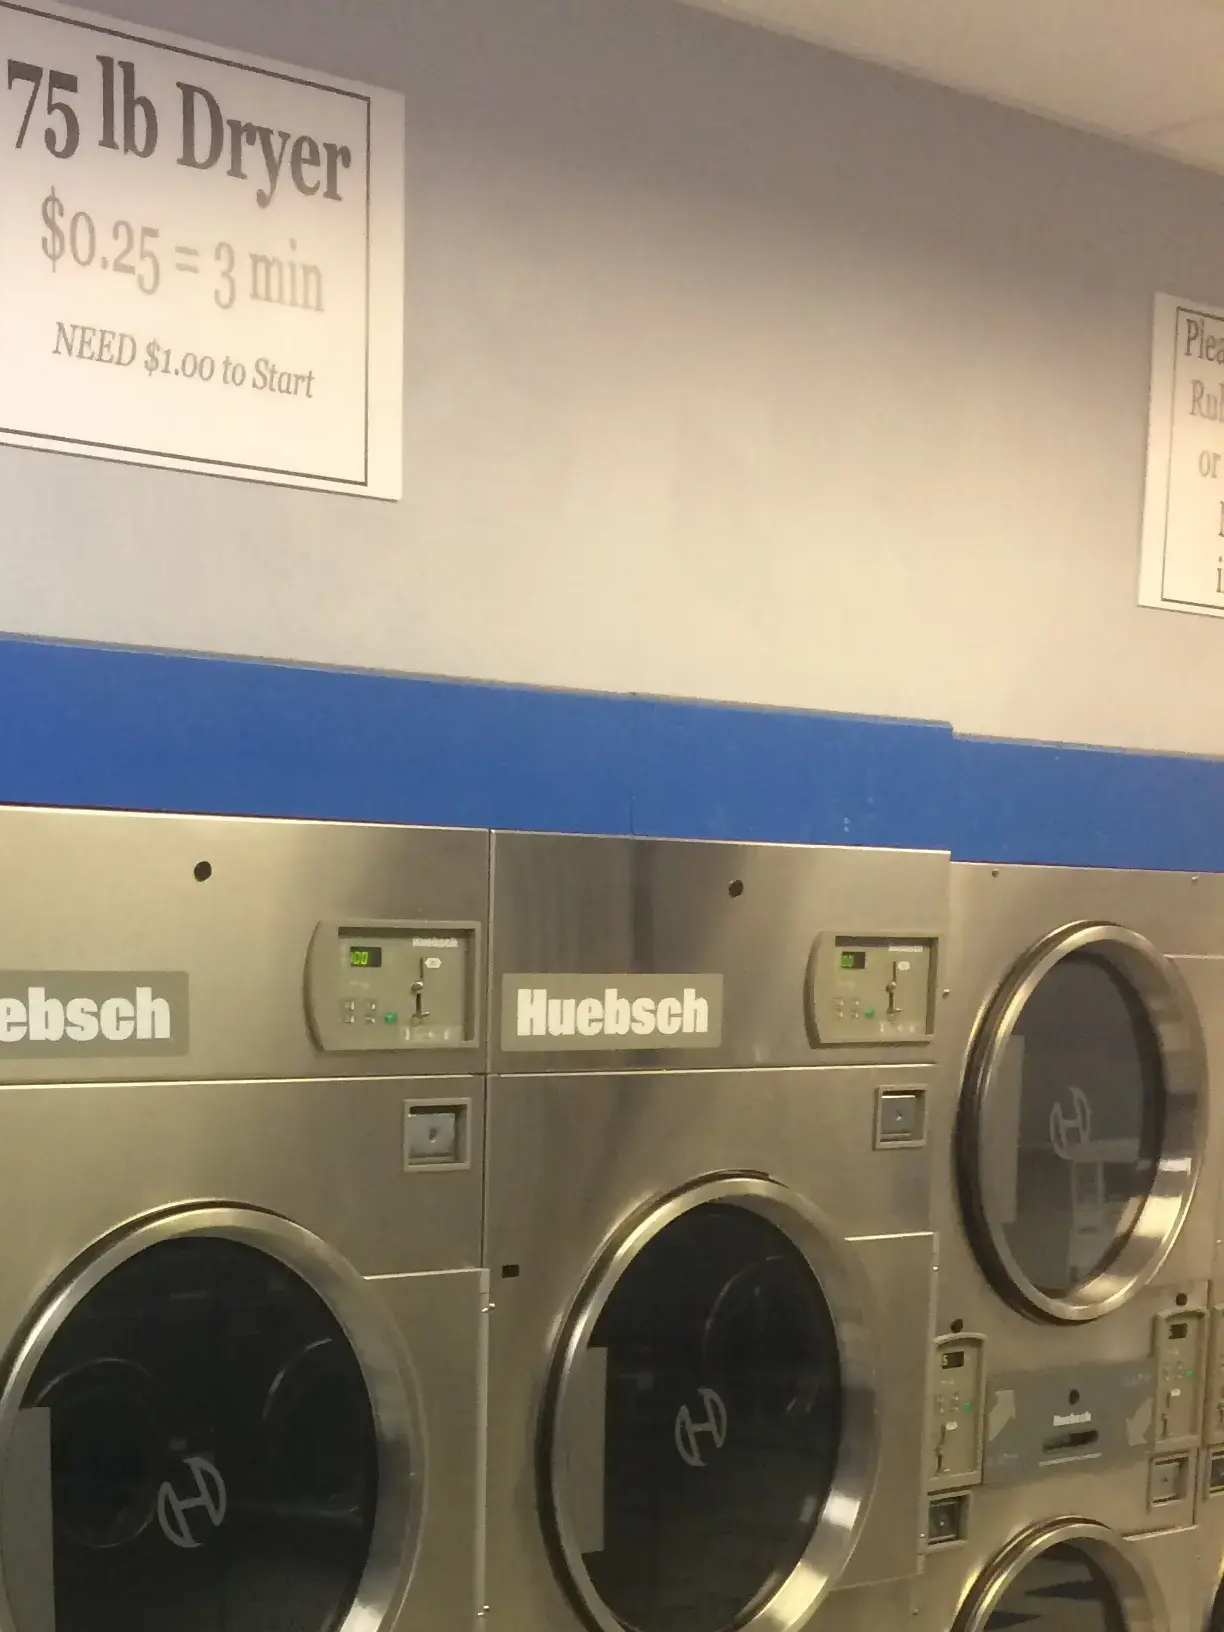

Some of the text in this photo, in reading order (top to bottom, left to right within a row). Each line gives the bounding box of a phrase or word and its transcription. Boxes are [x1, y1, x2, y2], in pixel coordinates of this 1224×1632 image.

[7, 55, 352, 209] 75 lb Dryer
[41, 185, 160, 295] $0.25
[213, 241, 236, 310] 3
[249, 238, 325, 312] min
[52, 321, 315, 399] NEED $1.00 to Start
[1199, 450, 1221, 479] or
[517, 988, 709, 1036] Huebsch
